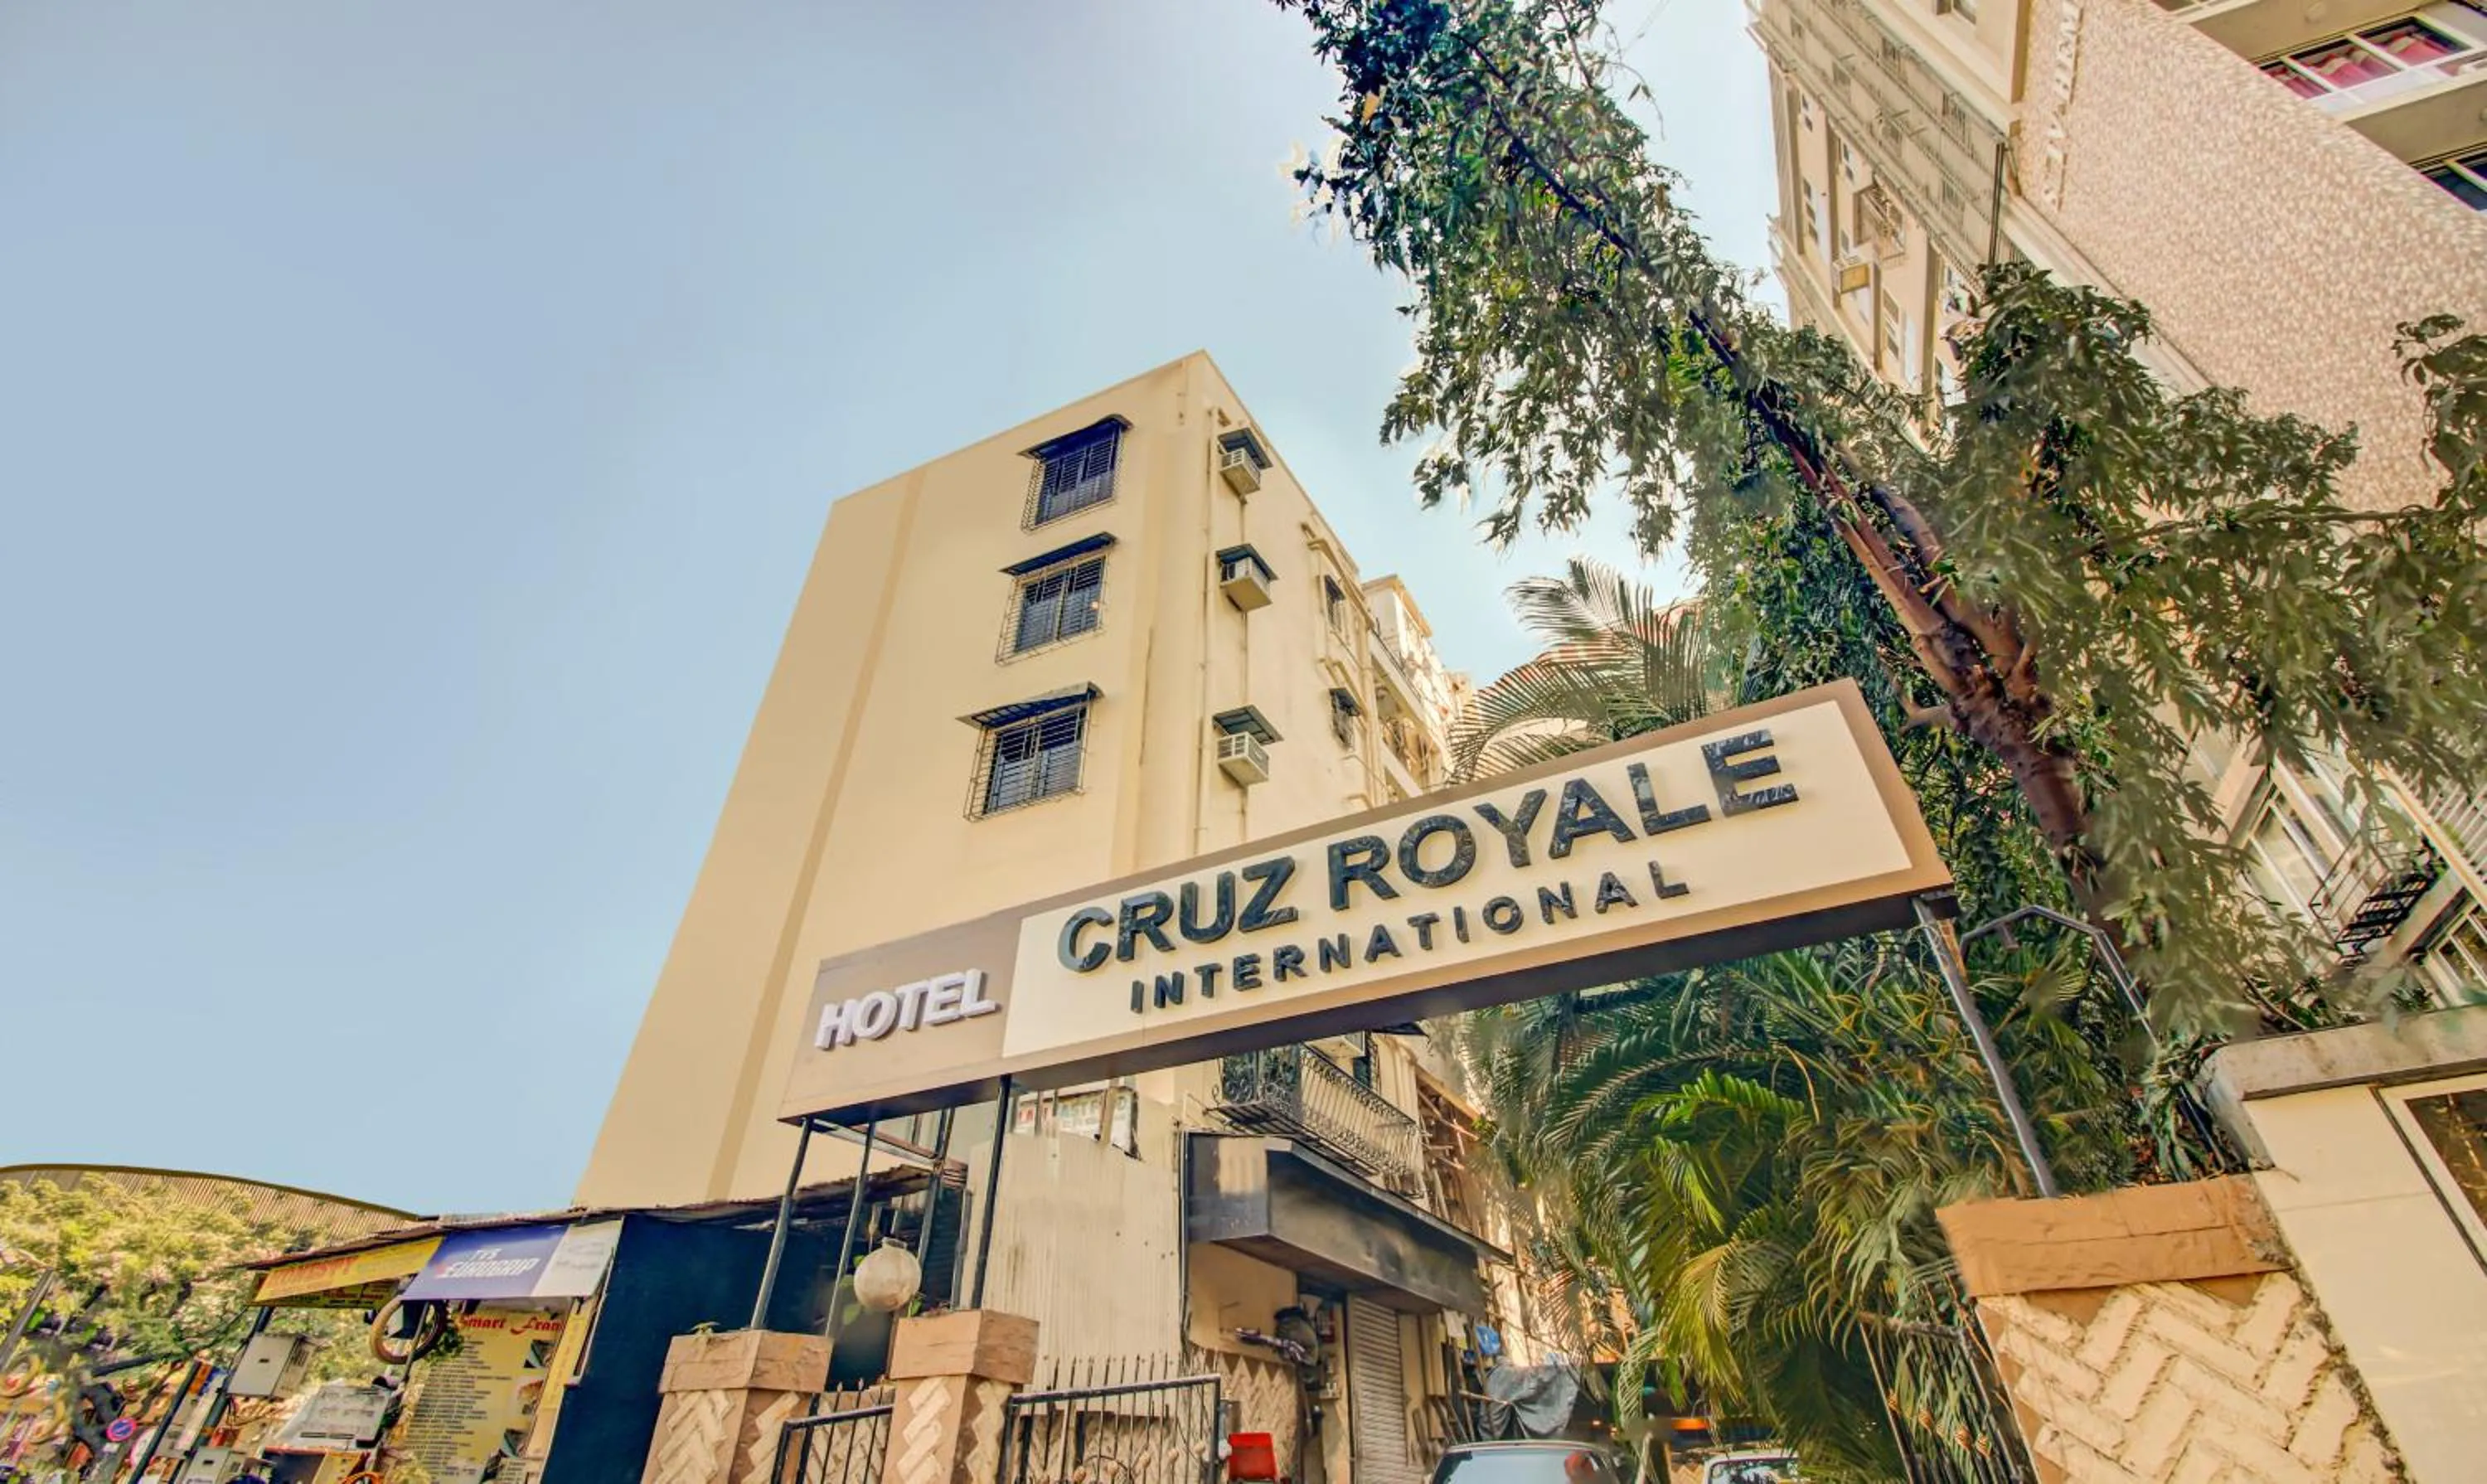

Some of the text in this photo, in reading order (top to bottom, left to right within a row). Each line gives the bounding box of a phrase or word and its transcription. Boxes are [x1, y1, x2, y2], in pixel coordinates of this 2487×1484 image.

[1058, 730, 1800, 972] CRUZ ROYALE
[814, 968, 998, 1050] HOTEL
[1130, 861, 1690, 1014] INTERNATIONAL
